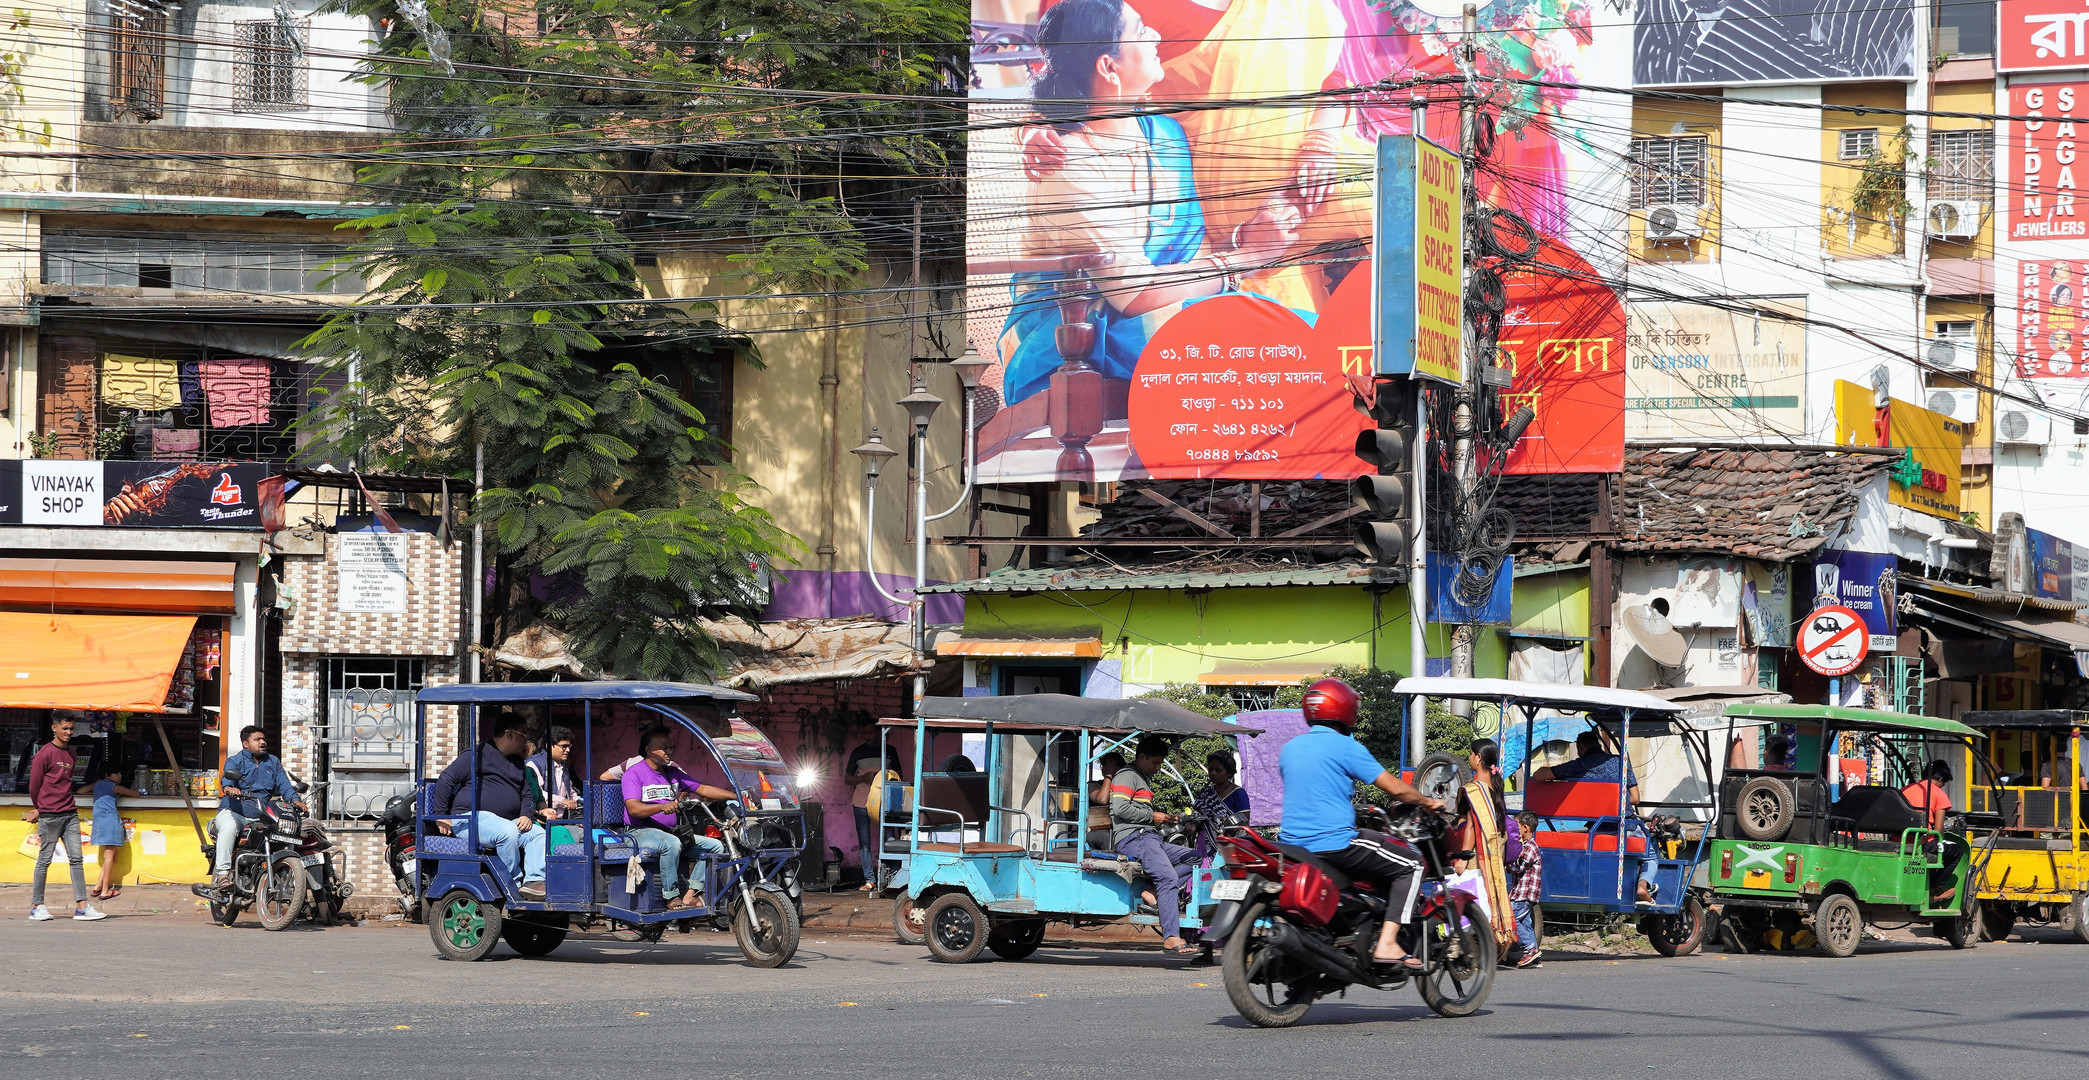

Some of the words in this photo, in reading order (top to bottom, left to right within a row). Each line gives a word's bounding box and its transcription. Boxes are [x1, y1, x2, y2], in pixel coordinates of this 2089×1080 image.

[2024, 12, 2089, 58] রা
[2024, 88, 2044, 217] GOLDEN
[2056, 87, 2076, 216] SAGAR
[1422, 150, 1441, 187] ADD
[1443, 160, 1455, 195] TO
[1428, 194, 1449, 234] THIS
[2013, 221, 2085, 237] JEWELLERS
[1424, 234, 1453, 277] SPACE
[1418, 281, 1460, 328] 8777790227
[1160, 348, 1182, 361] ৩১,
[1186, 345, 1203, 359] জি.
[1208, 344, 1224, 359] টি.
[1229, 347, 1256, 359] রোড
[1260, 344, 1307, 362] (সাউথ),
[1418, 325, 1460, 371] 9330705429
[1537, 337, 1613, 373] সেন
[1632, 355, 1649, 369] OF
[1652, 354, 1710, 369] SENSORY
[1714, 353, 1799, 369] INTEGRATION
[1140, 373, 1171, 388] দুলাল
[1175, 373, 1198, 385] সেন
[1201, 369, 1241, 386] মার্কেট,
[1246, 372, 1281, 387] হাওড়া
[1285, 371, 1327, 386] ময়দান,
[1697, 374, 1747, 389] CENTRE
[1181, 397, 1217, 412] হাওড়া
[1231, 398, 1254, 410] ৭১১
[1259, 398, 1284, 410] ১০১
[1625, 399, 1640, 409] ARE
[1654, 398, 1667, 408] THE
[1669, 398, 1697, 408] SPECIAL
[1698, 397, 1733, 408] CHILDREN
[1170, 423, 1198, 436] ফোন
[1212, 423, 1246, 436] ২৬৪১
[1251, 423, 1287, 436] ৪২৬২
[1186, 449, 1229, 461] ৭০৪৪৪
[31, 475, 95, 493] VINAYAK
[42, 497, 84, 514] SHOP
[212, 508, 254, 519] Thunder
[1842, 580, 1873, 597] Winner
[1843, 598, 1854, 608] ice
[1854, 599, 1872, 610] cream
[1718, 640, 1738, 648] FREE
[1801, 654, 1826, 674] HOWRAH
[1826, 668, 1840, 676] CITY
[1841, 656, 1862, 672] POLICE
